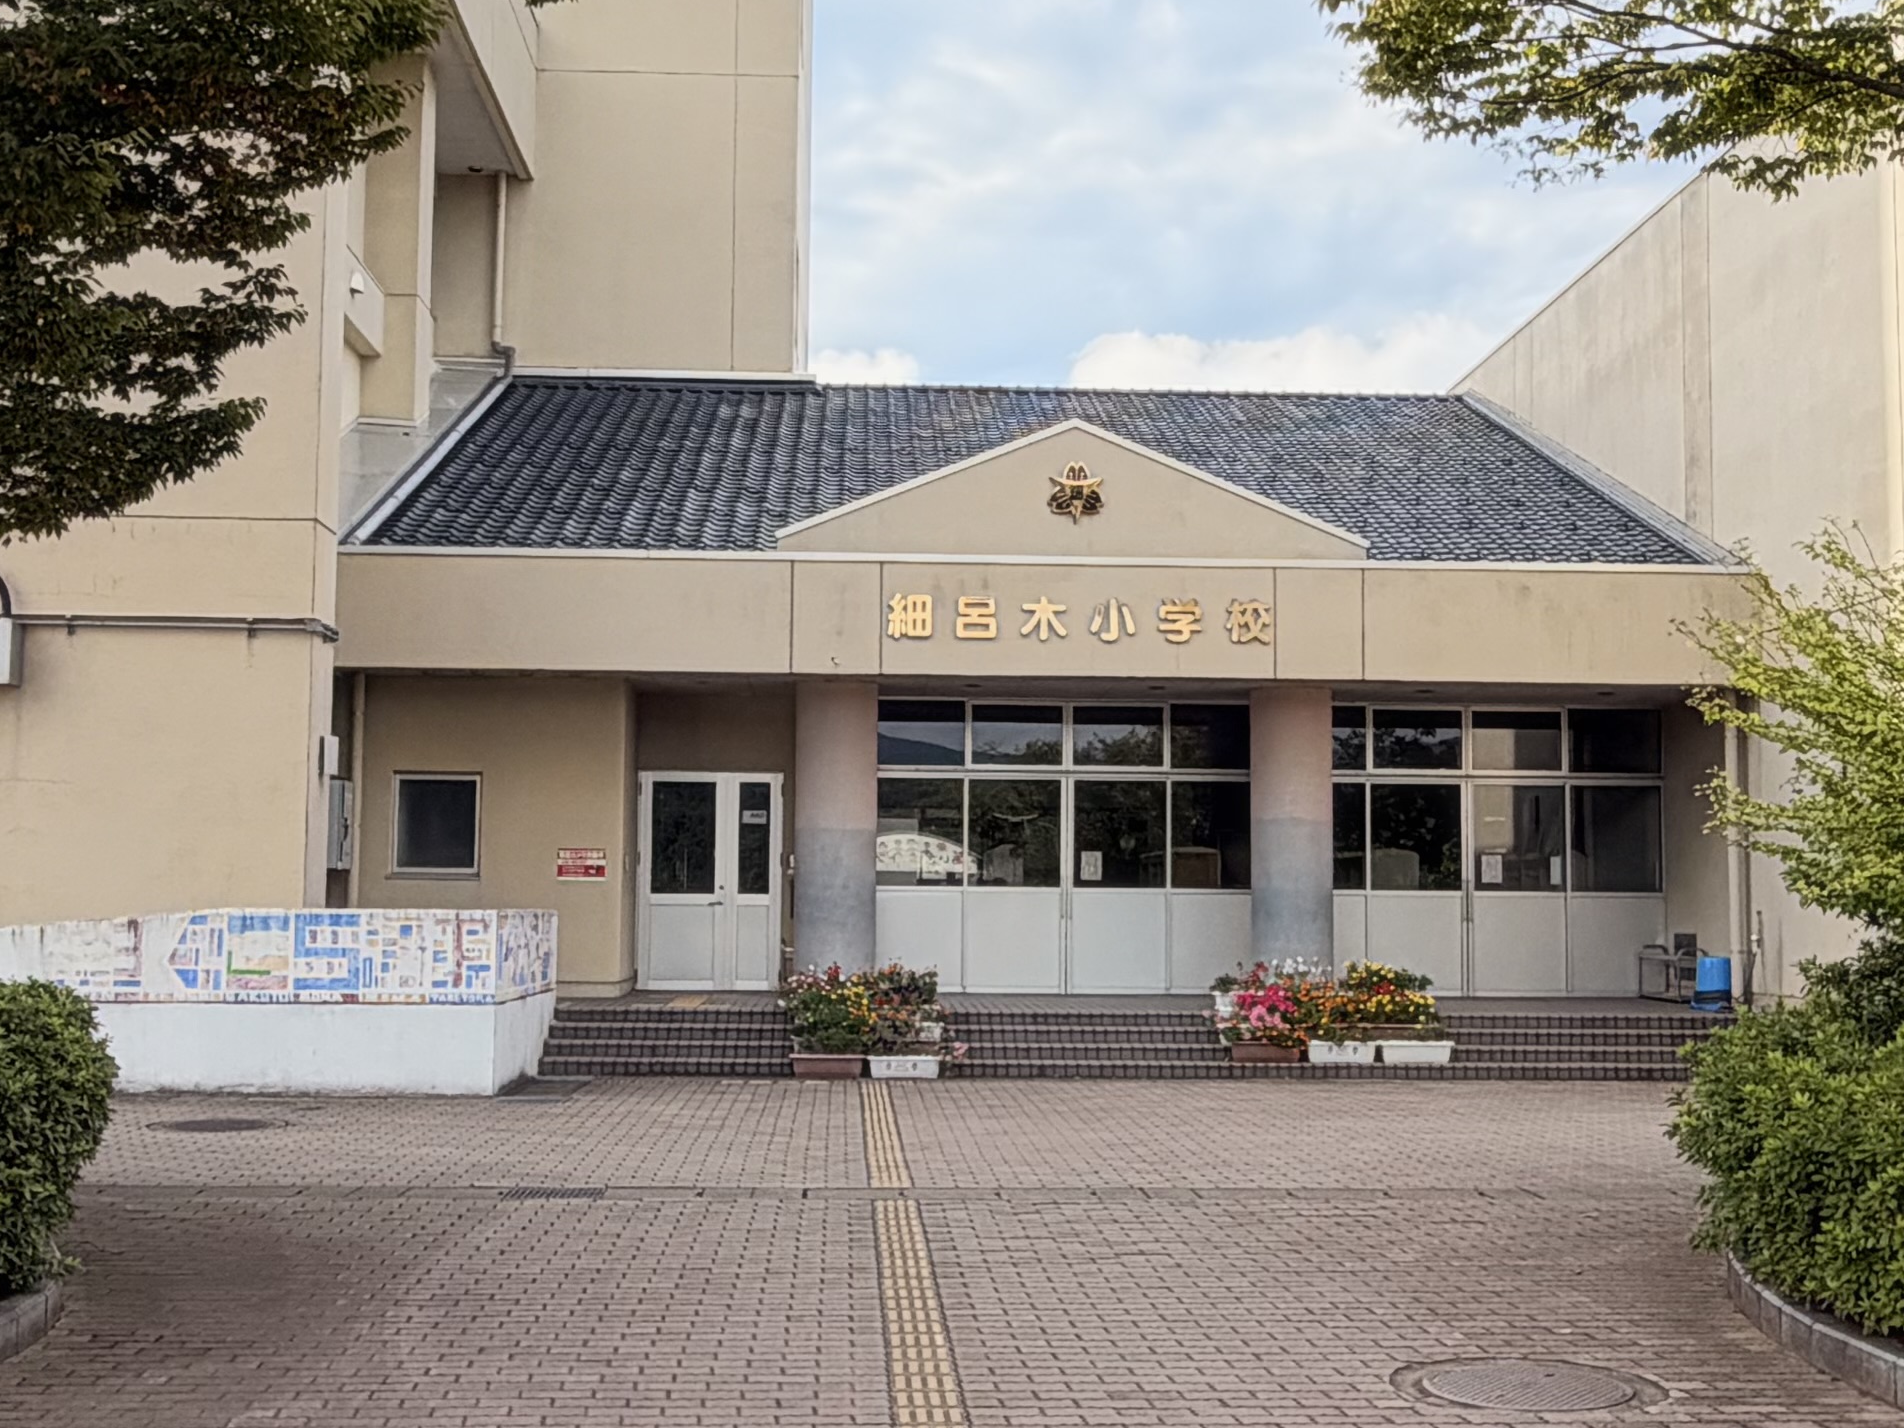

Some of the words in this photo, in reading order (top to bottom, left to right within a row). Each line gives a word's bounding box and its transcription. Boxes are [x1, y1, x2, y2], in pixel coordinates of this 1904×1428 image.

[887, 593, 1272, 645] 細呂木小学校
